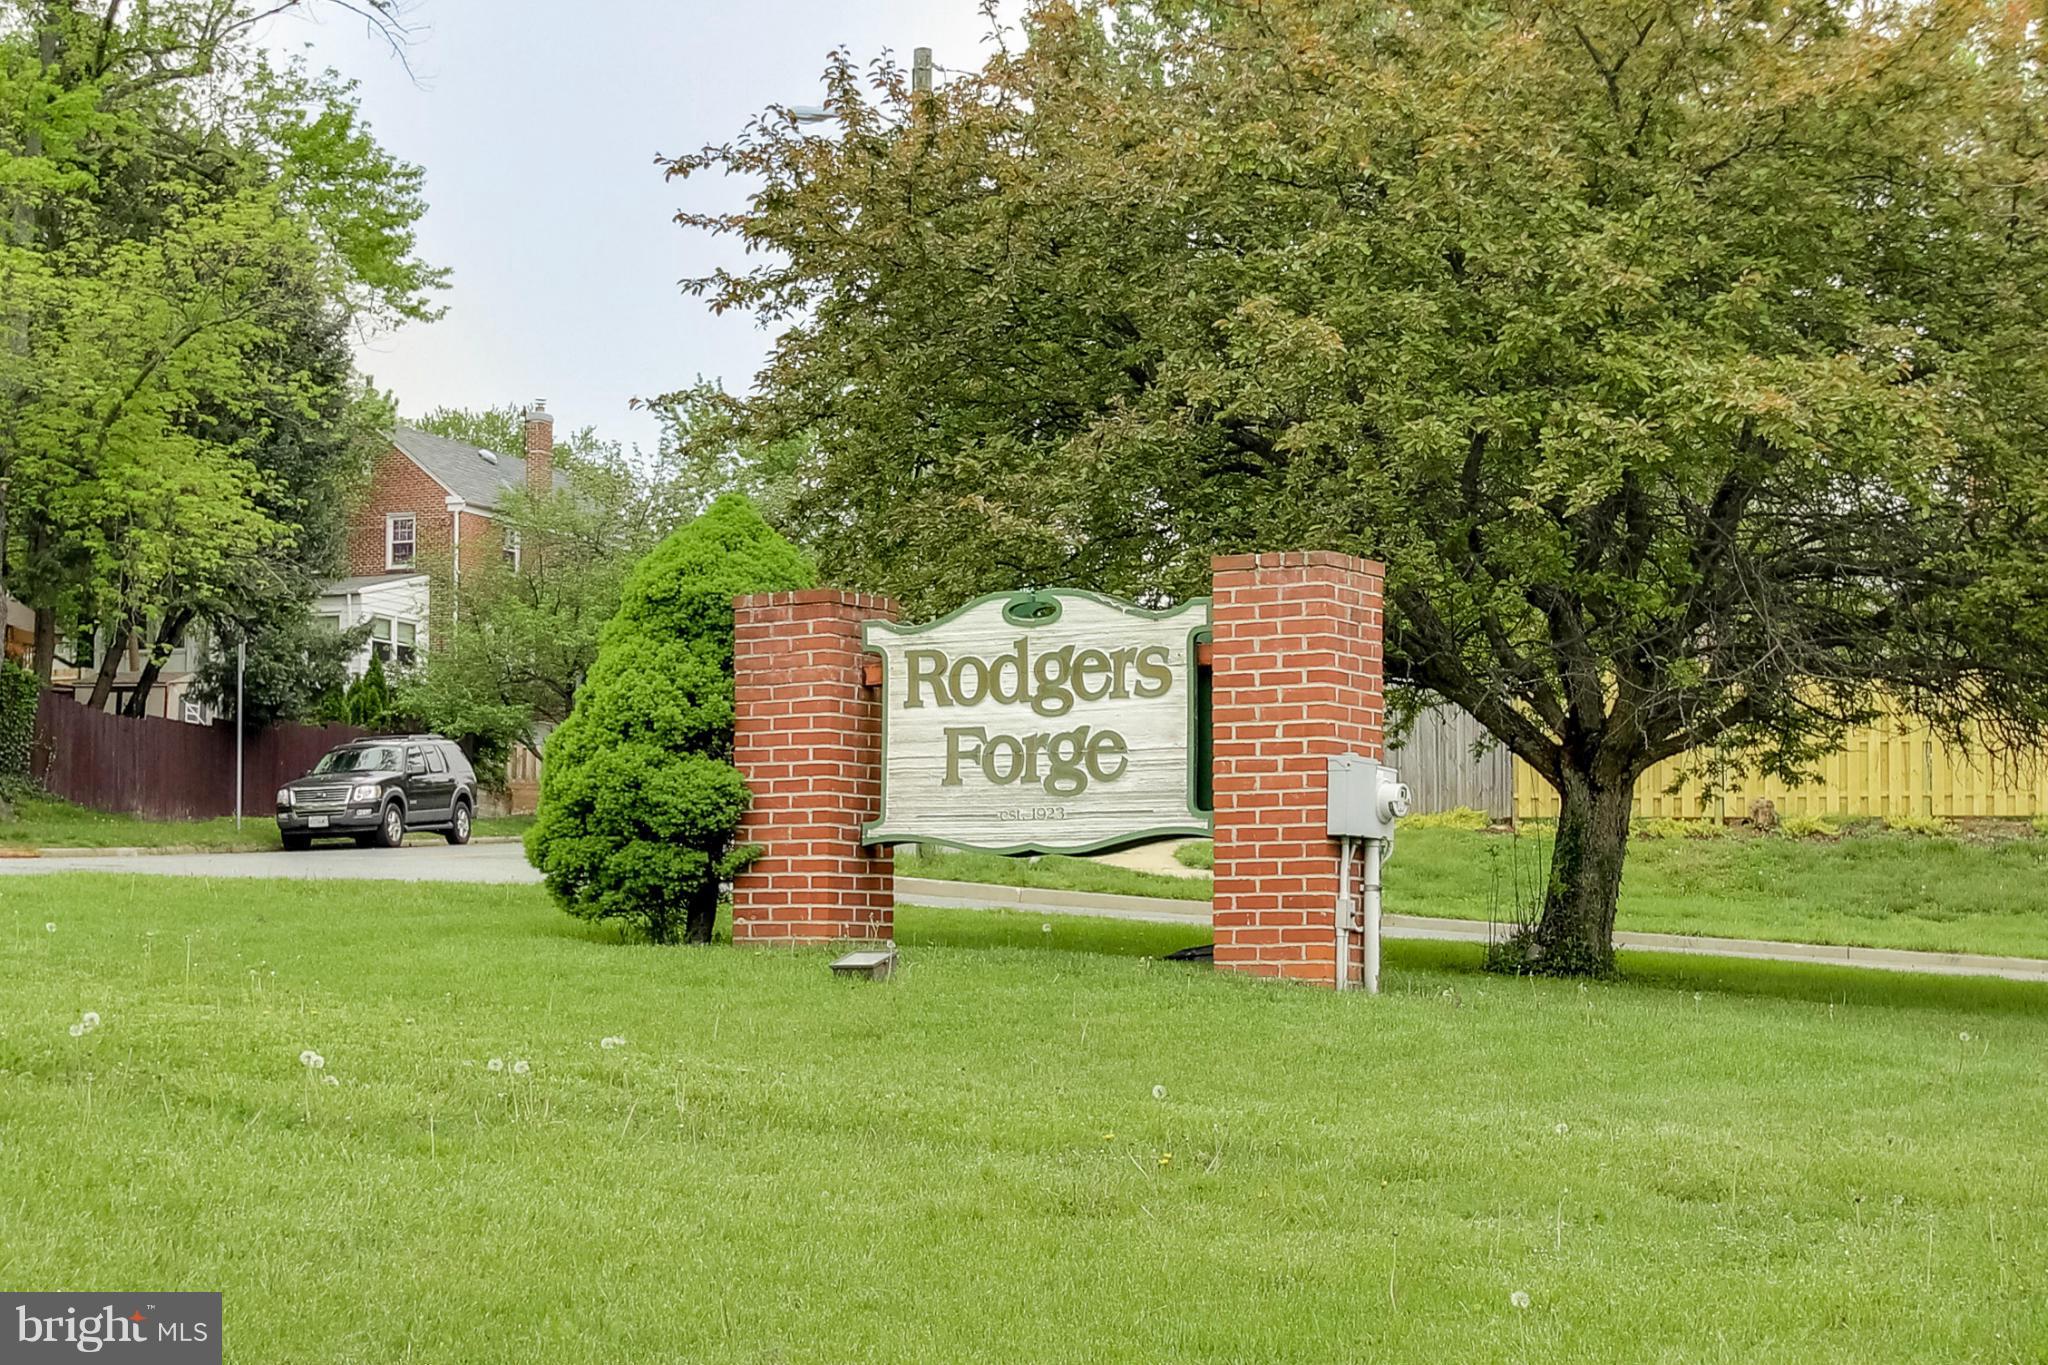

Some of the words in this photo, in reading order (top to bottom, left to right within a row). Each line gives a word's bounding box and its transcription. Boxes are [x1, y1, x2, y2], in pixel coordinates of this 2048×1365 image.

[903, 636, 1173, 717] Rodgers
[941, 725, 1128, 796] Forge
[999, 808, 1025, 821] est.
[1032, 806, 1065, 821] 1923
